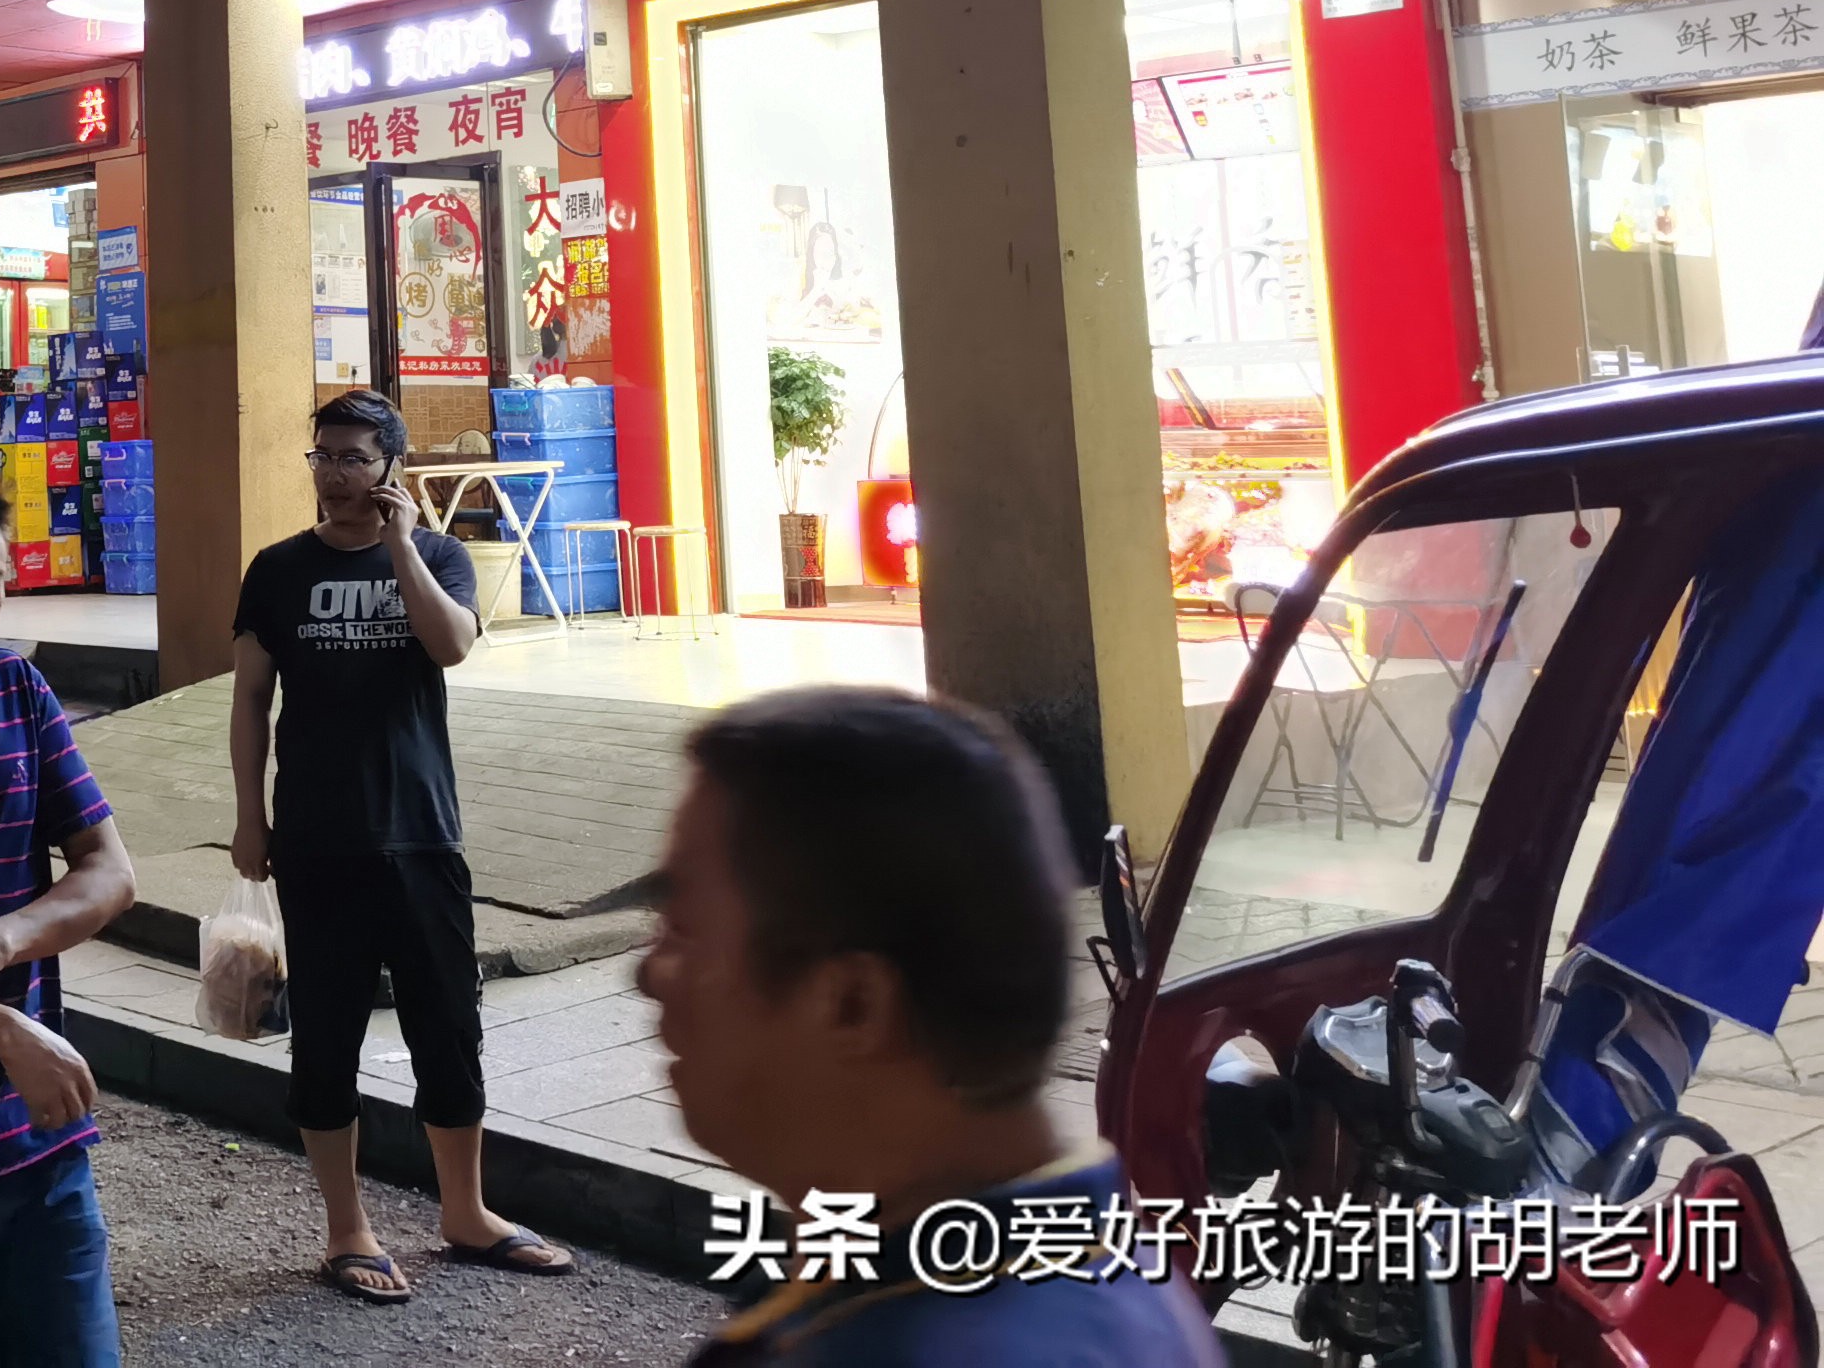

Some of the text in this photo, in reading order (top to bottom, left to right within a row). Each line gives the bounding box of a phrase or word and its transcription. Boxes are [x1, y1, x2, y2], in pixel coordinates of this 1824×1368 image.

[1537, 2, 1819, 73] 奶茶 鲜果茶
[347, 105, 420, 163] 晚餐
[448, 87, 527, 148] 夜宵
